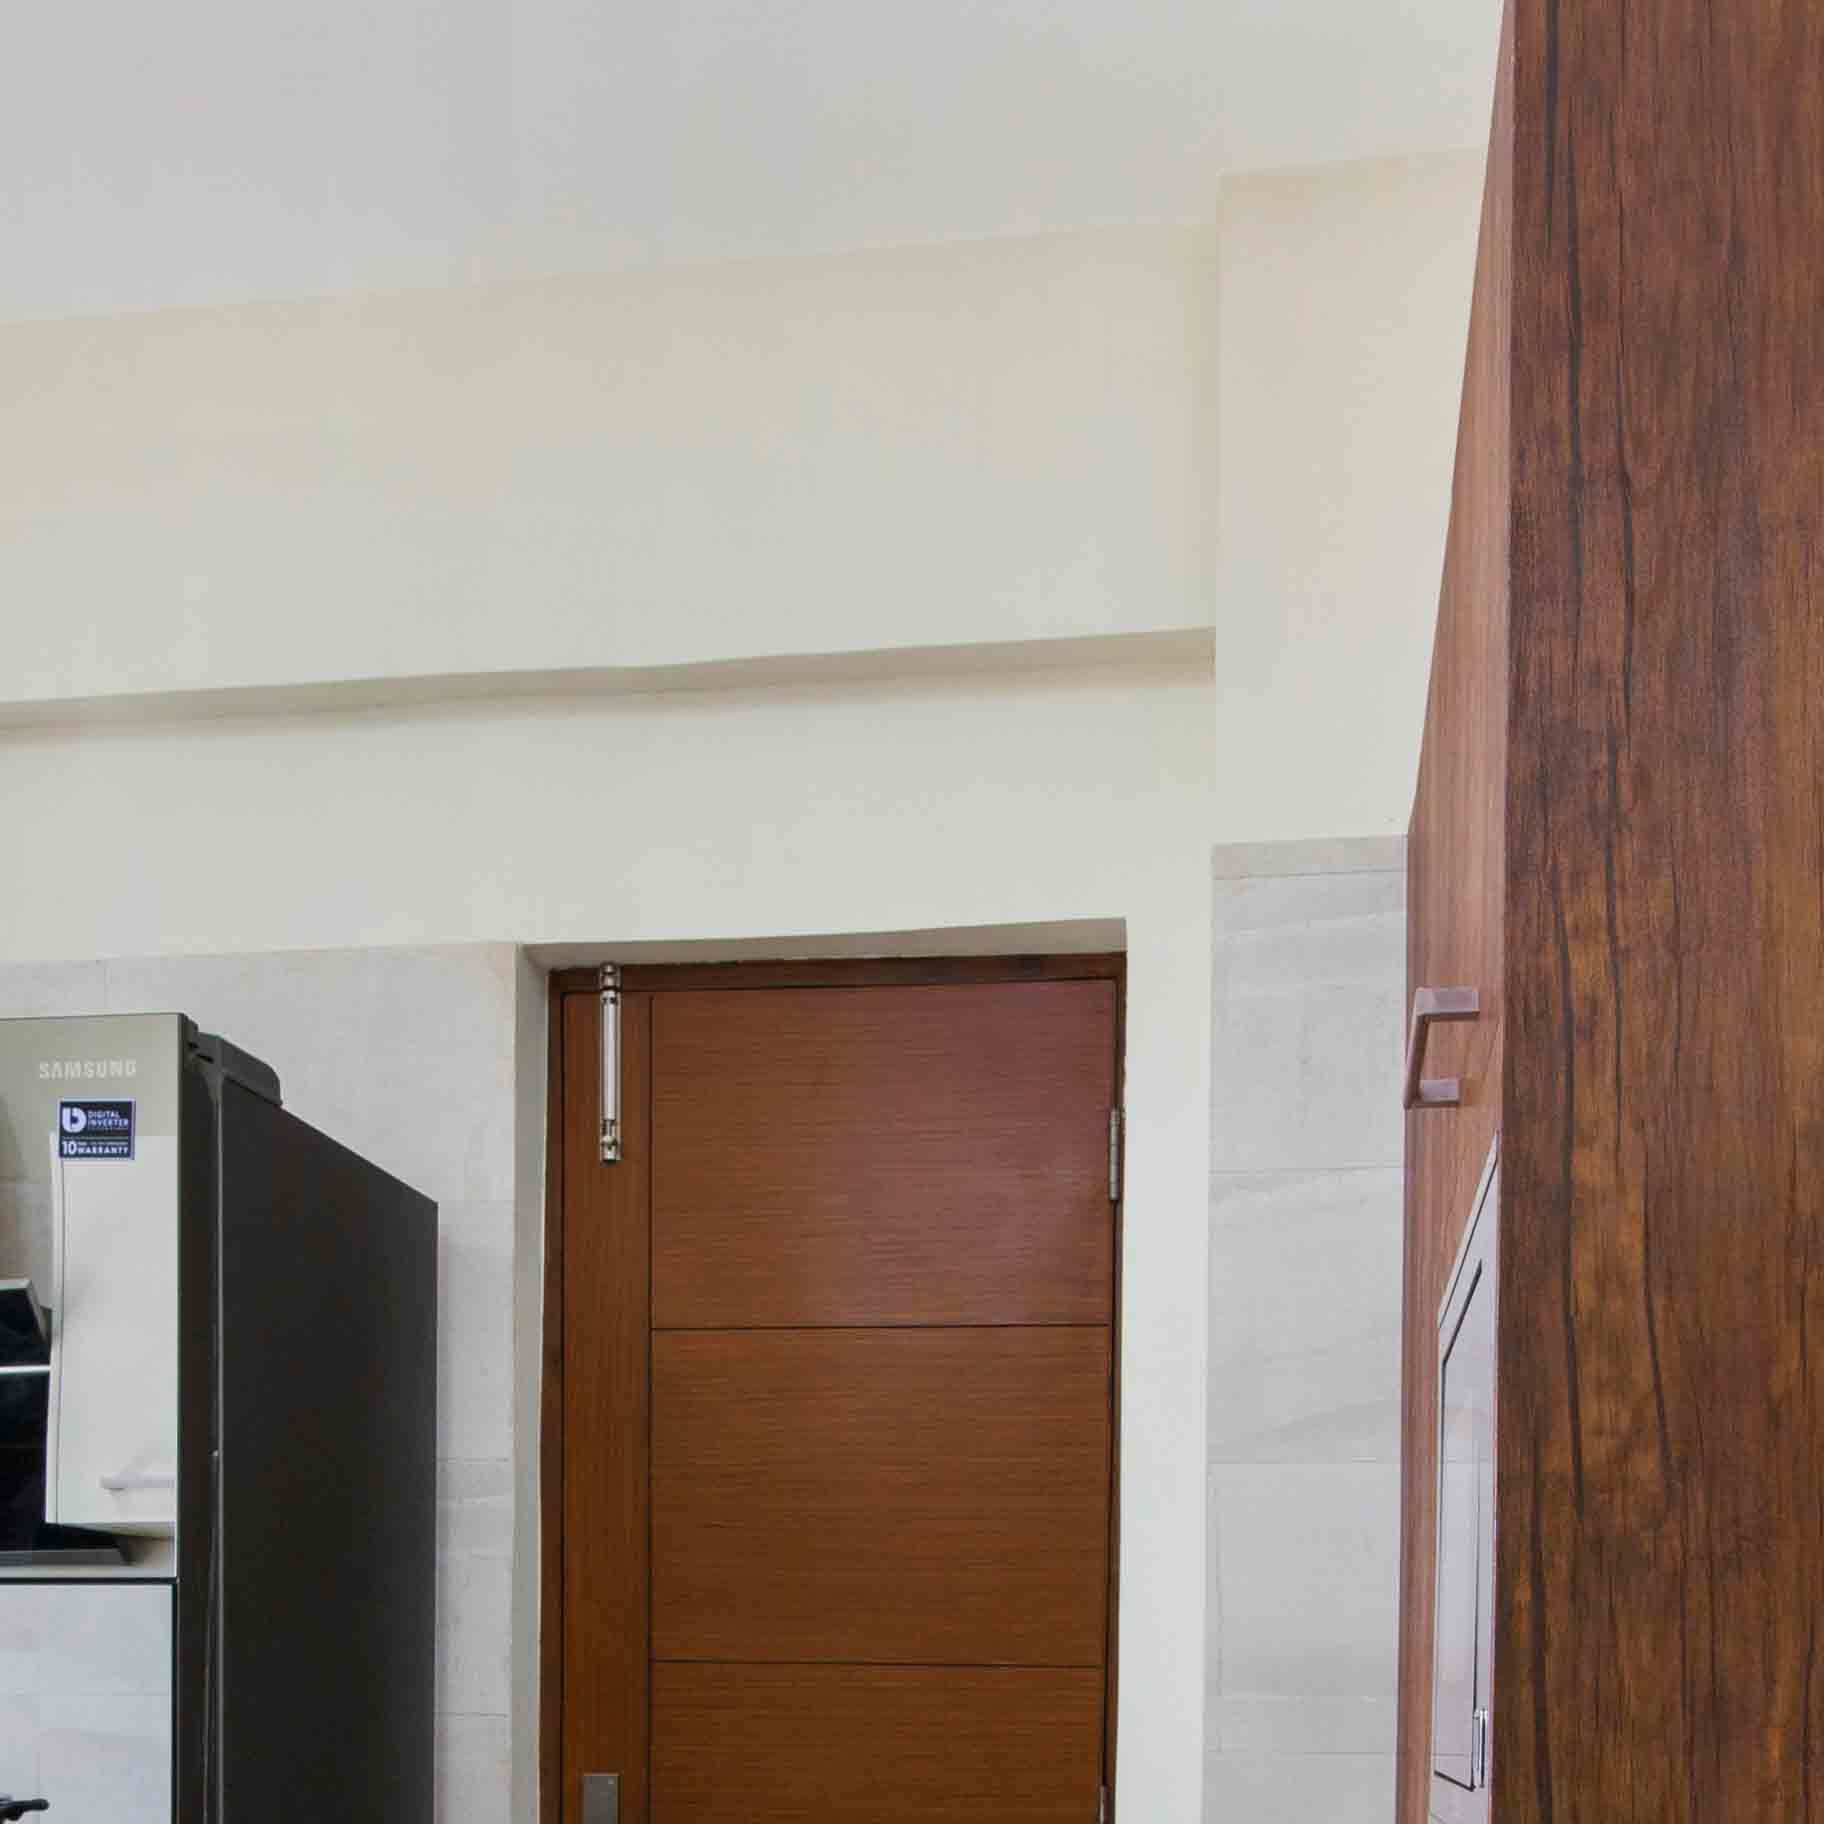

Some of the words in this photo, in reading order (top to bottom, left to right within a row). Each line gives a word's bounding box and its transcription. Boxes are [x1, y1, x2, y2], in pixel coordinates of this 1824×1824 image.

[39, 1060, 136, 1080] SAMSUNG
[88, 1110, 120, 1119] DIGITAL
[88, 1118, 129, 1128] INVERTER
[62, 1141, 77, 1155] 10
[77, 1146, 129, 1155] WARRANTY
